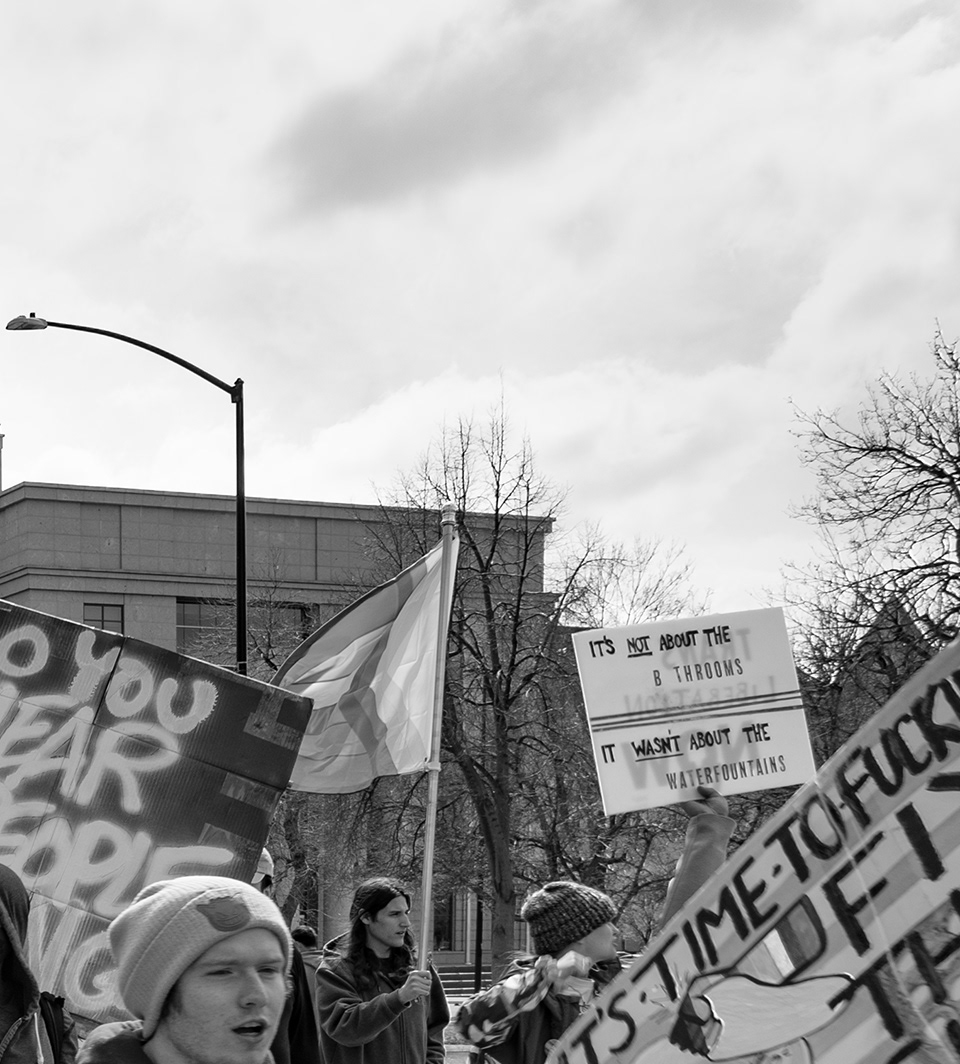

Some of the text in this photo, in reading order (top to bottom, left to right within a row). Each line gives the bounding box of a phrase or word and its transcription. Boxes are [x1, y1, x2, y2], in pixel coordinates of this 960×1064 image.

[589, 625, 731, 658] IT'S NOT ABOUT THE
[69, 629, 220, 735] YOU
[673, 658, 744, 683] THROOMS
[601, 723, 771, 764] IT WASN'T ABOUT THE
[666, 755, 787, 790] WATERFOUNTAINS
